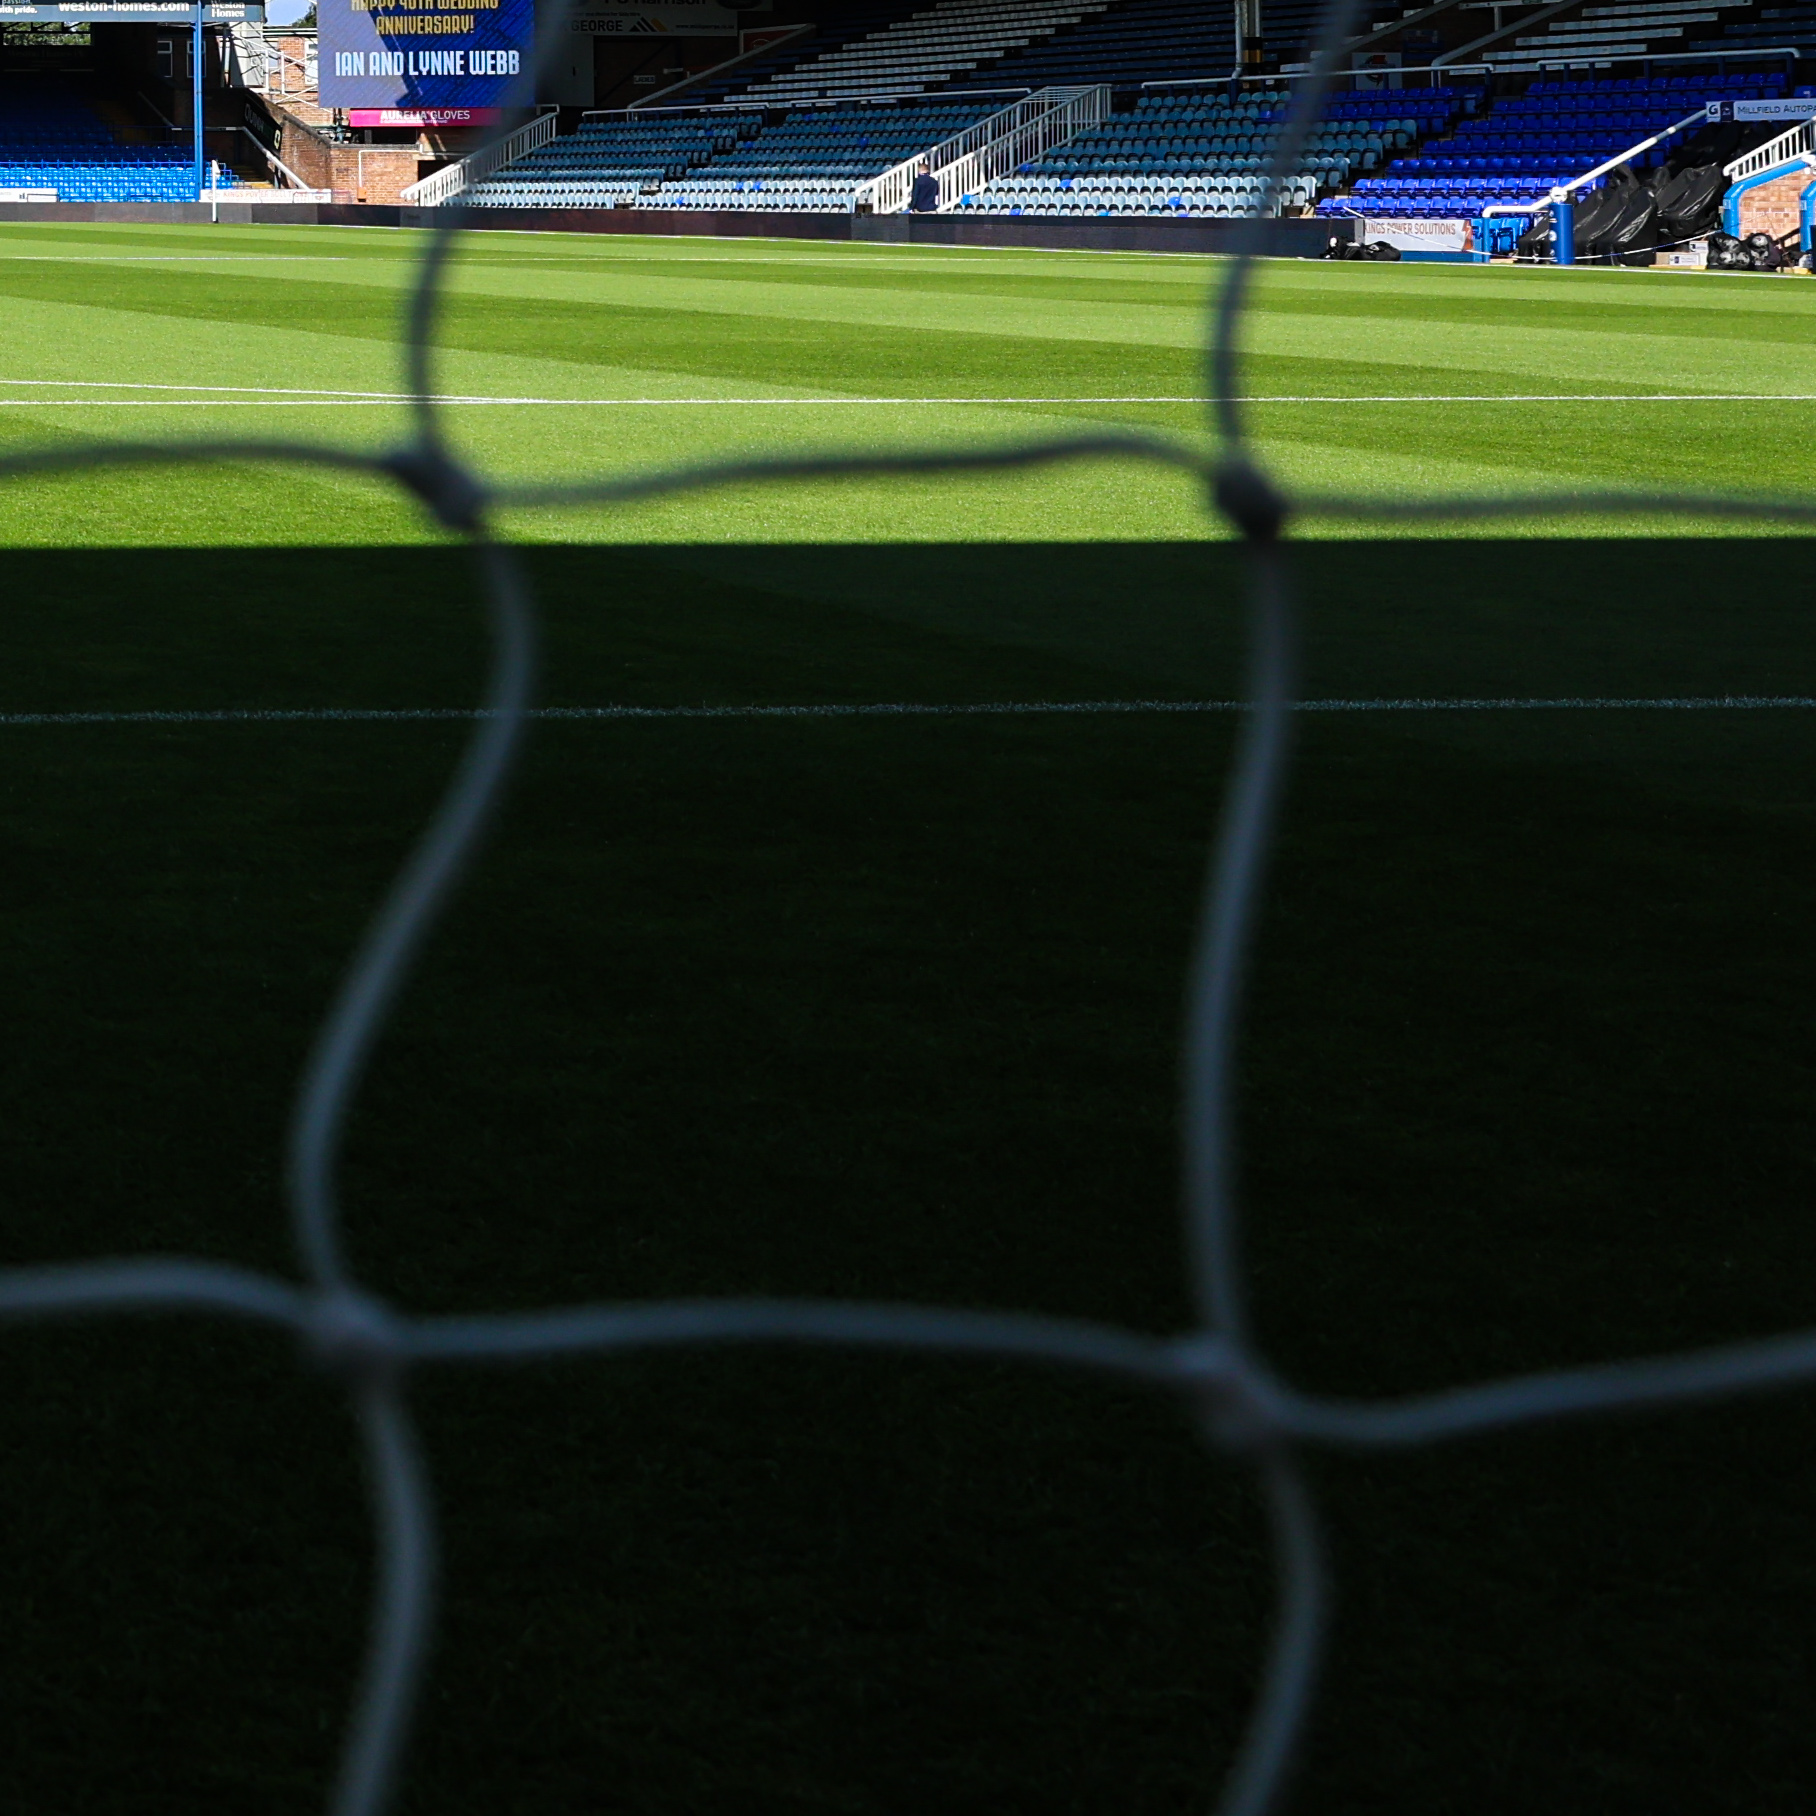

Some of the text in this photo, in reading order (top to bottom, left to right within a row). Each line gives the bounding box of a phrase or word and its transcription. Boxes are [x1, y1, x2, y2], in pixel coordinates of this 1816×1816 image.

[14, 6, 37, 15] pride.
[58, 0, 189, 12] weston-homes.com
[212, 9, 245, 18] Homes
[376, 15, 475, 35] ANNIVERSARY!
[571, 19, 623, 32] GEORGE
[335, 50, 520, 77] IAN AND LYNNE WEBB
[380, 110, 470, 120] AURELIA GLOVES
[1737, 105, 1781, 115] MILLFIELD
[1365, 223, 1456, 235] KINGS POWER SOLUTIONS
